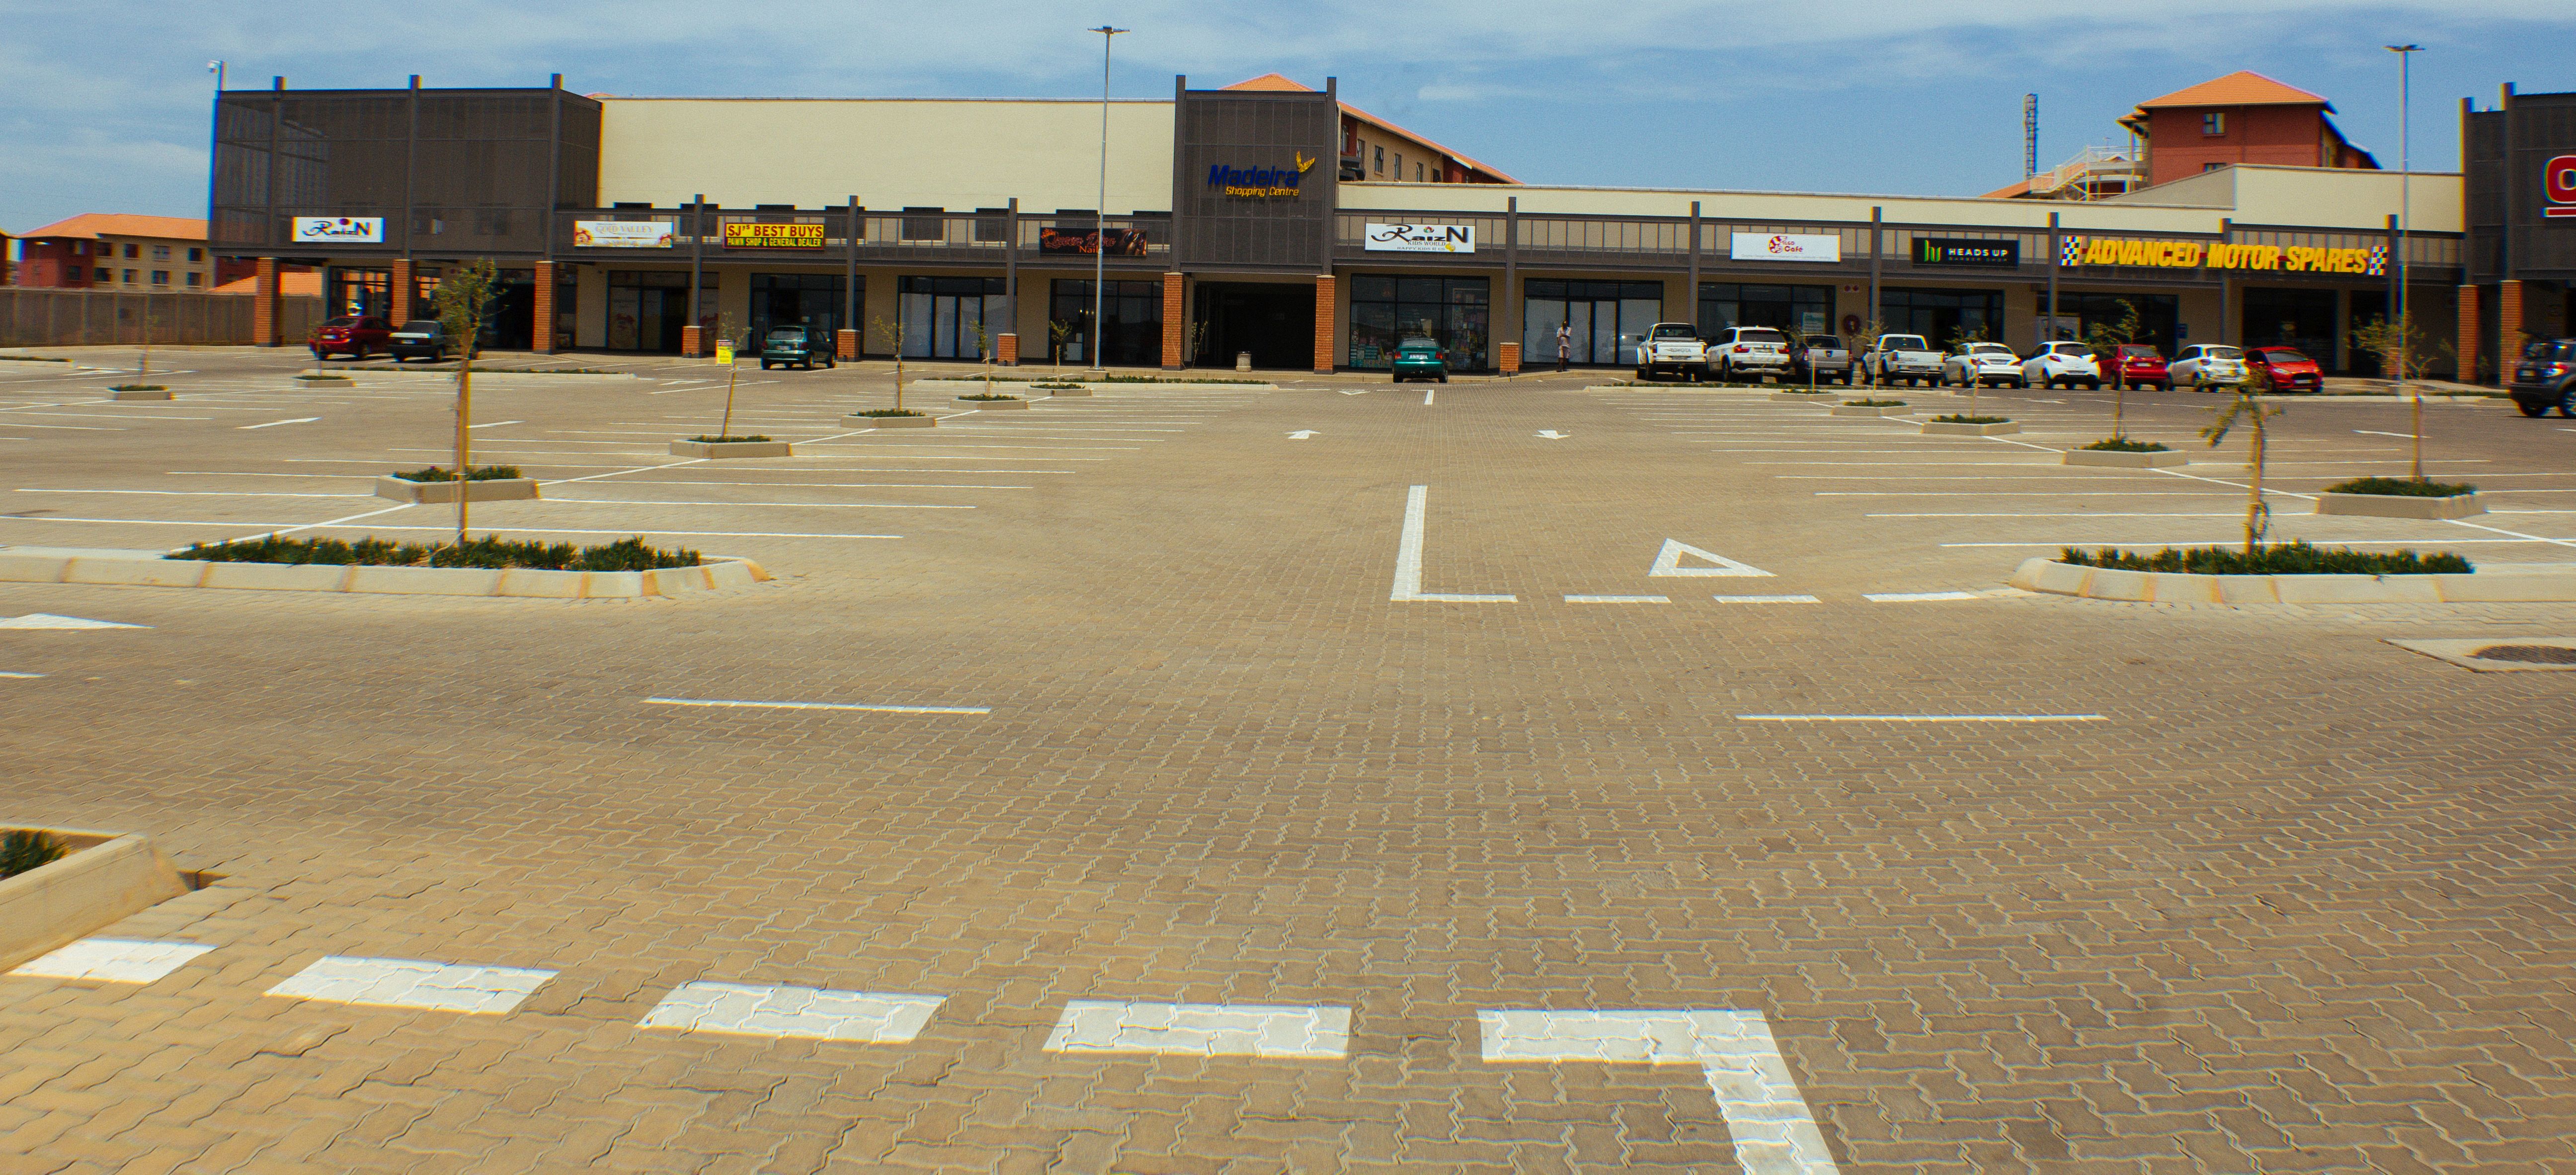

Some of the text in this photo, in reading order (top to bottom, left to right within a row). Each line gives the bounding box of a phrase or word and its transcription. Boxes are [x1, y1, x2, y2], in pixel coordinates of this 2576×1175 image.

[1208, 165, 1299, 186] Madeira
[1225, 186, 1299, 197] Shopping Centre
[754, 226, 786, 237] BEST
[790, 226, 822, 237] BUYS
[746, 238, 762, 246] SHOP
[763, 238, 769, 246] &
[769, 238, 798, 247] GENERAL
[798, 238, 821, 247] DEALER
[1947, 248, 1989, 256] HEADS
[2084, 239, 2370, 273] ADVANCED MOTOR SPARES
